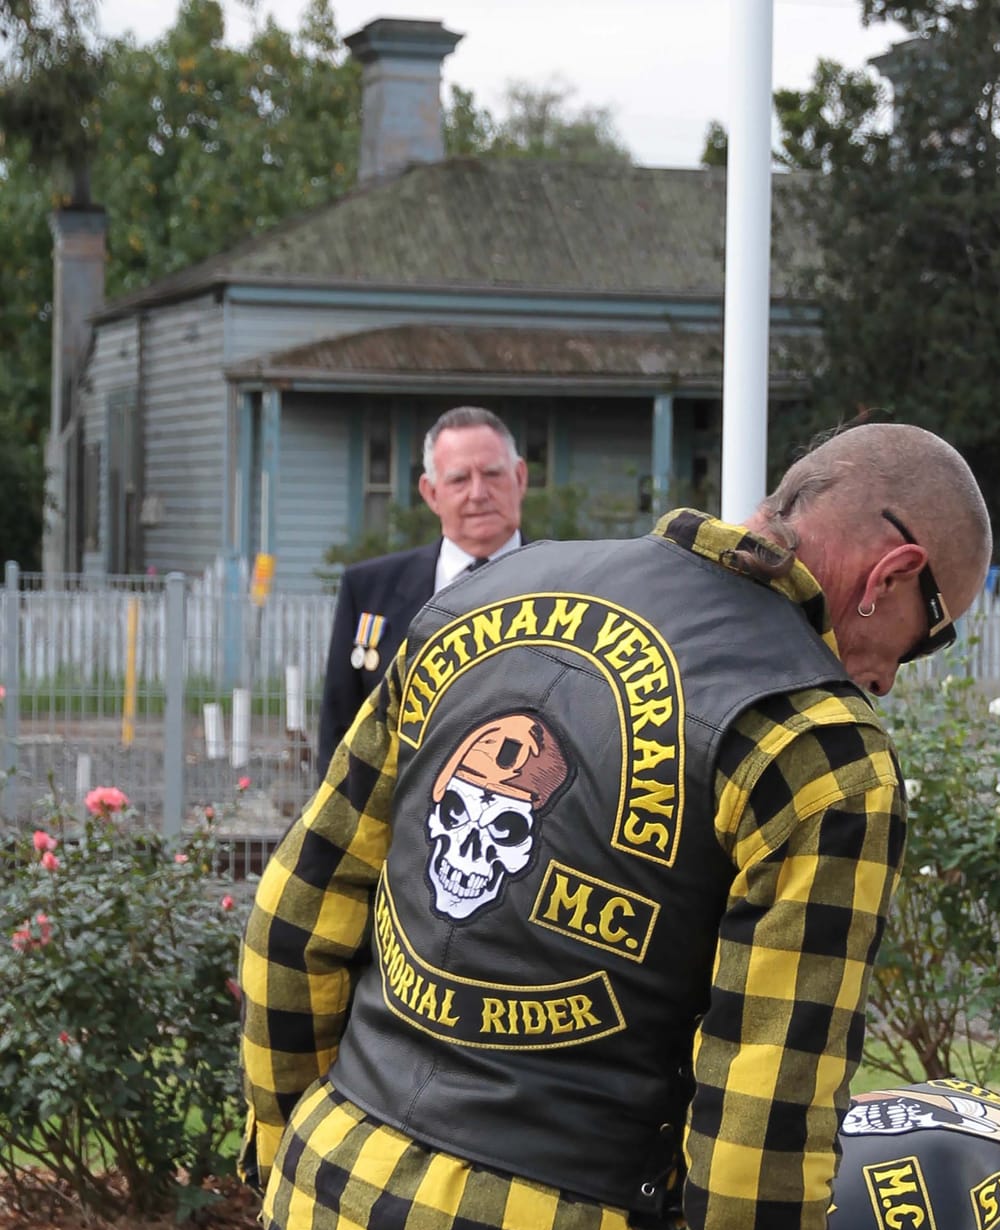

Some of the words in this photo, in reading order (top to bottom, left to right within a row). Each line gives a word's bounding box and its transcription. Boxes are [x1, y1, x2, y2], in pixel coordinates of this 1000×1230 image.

[402, 598, 590, 724] VIETNAM
[592, 611, 677, 853] VETERANS
[377, 890, 460, 1028] MEMORIAL
[480, 993, 602, 1035] RIDER
[543, 872, 639, 949] M.C.
